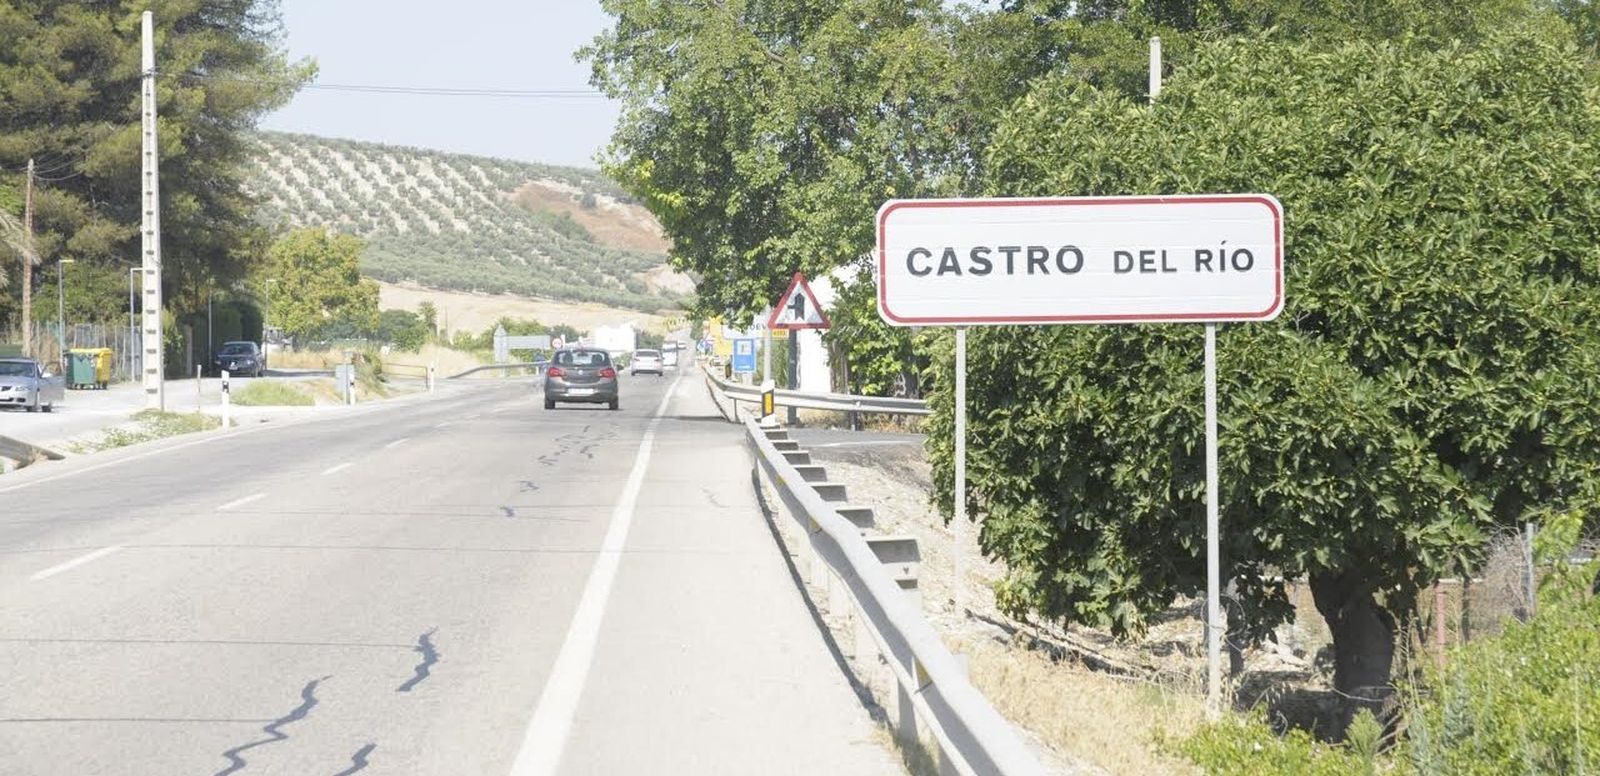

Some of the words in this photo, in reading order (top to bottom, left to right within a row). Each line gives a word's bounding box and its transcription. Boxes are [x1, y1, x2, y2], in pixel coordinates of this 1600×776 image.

[906, 245, 1084, 276] CASTRO
[1113, 250, 1177, 273] DEL
[1194, 241, 1255, 273] RÍO
